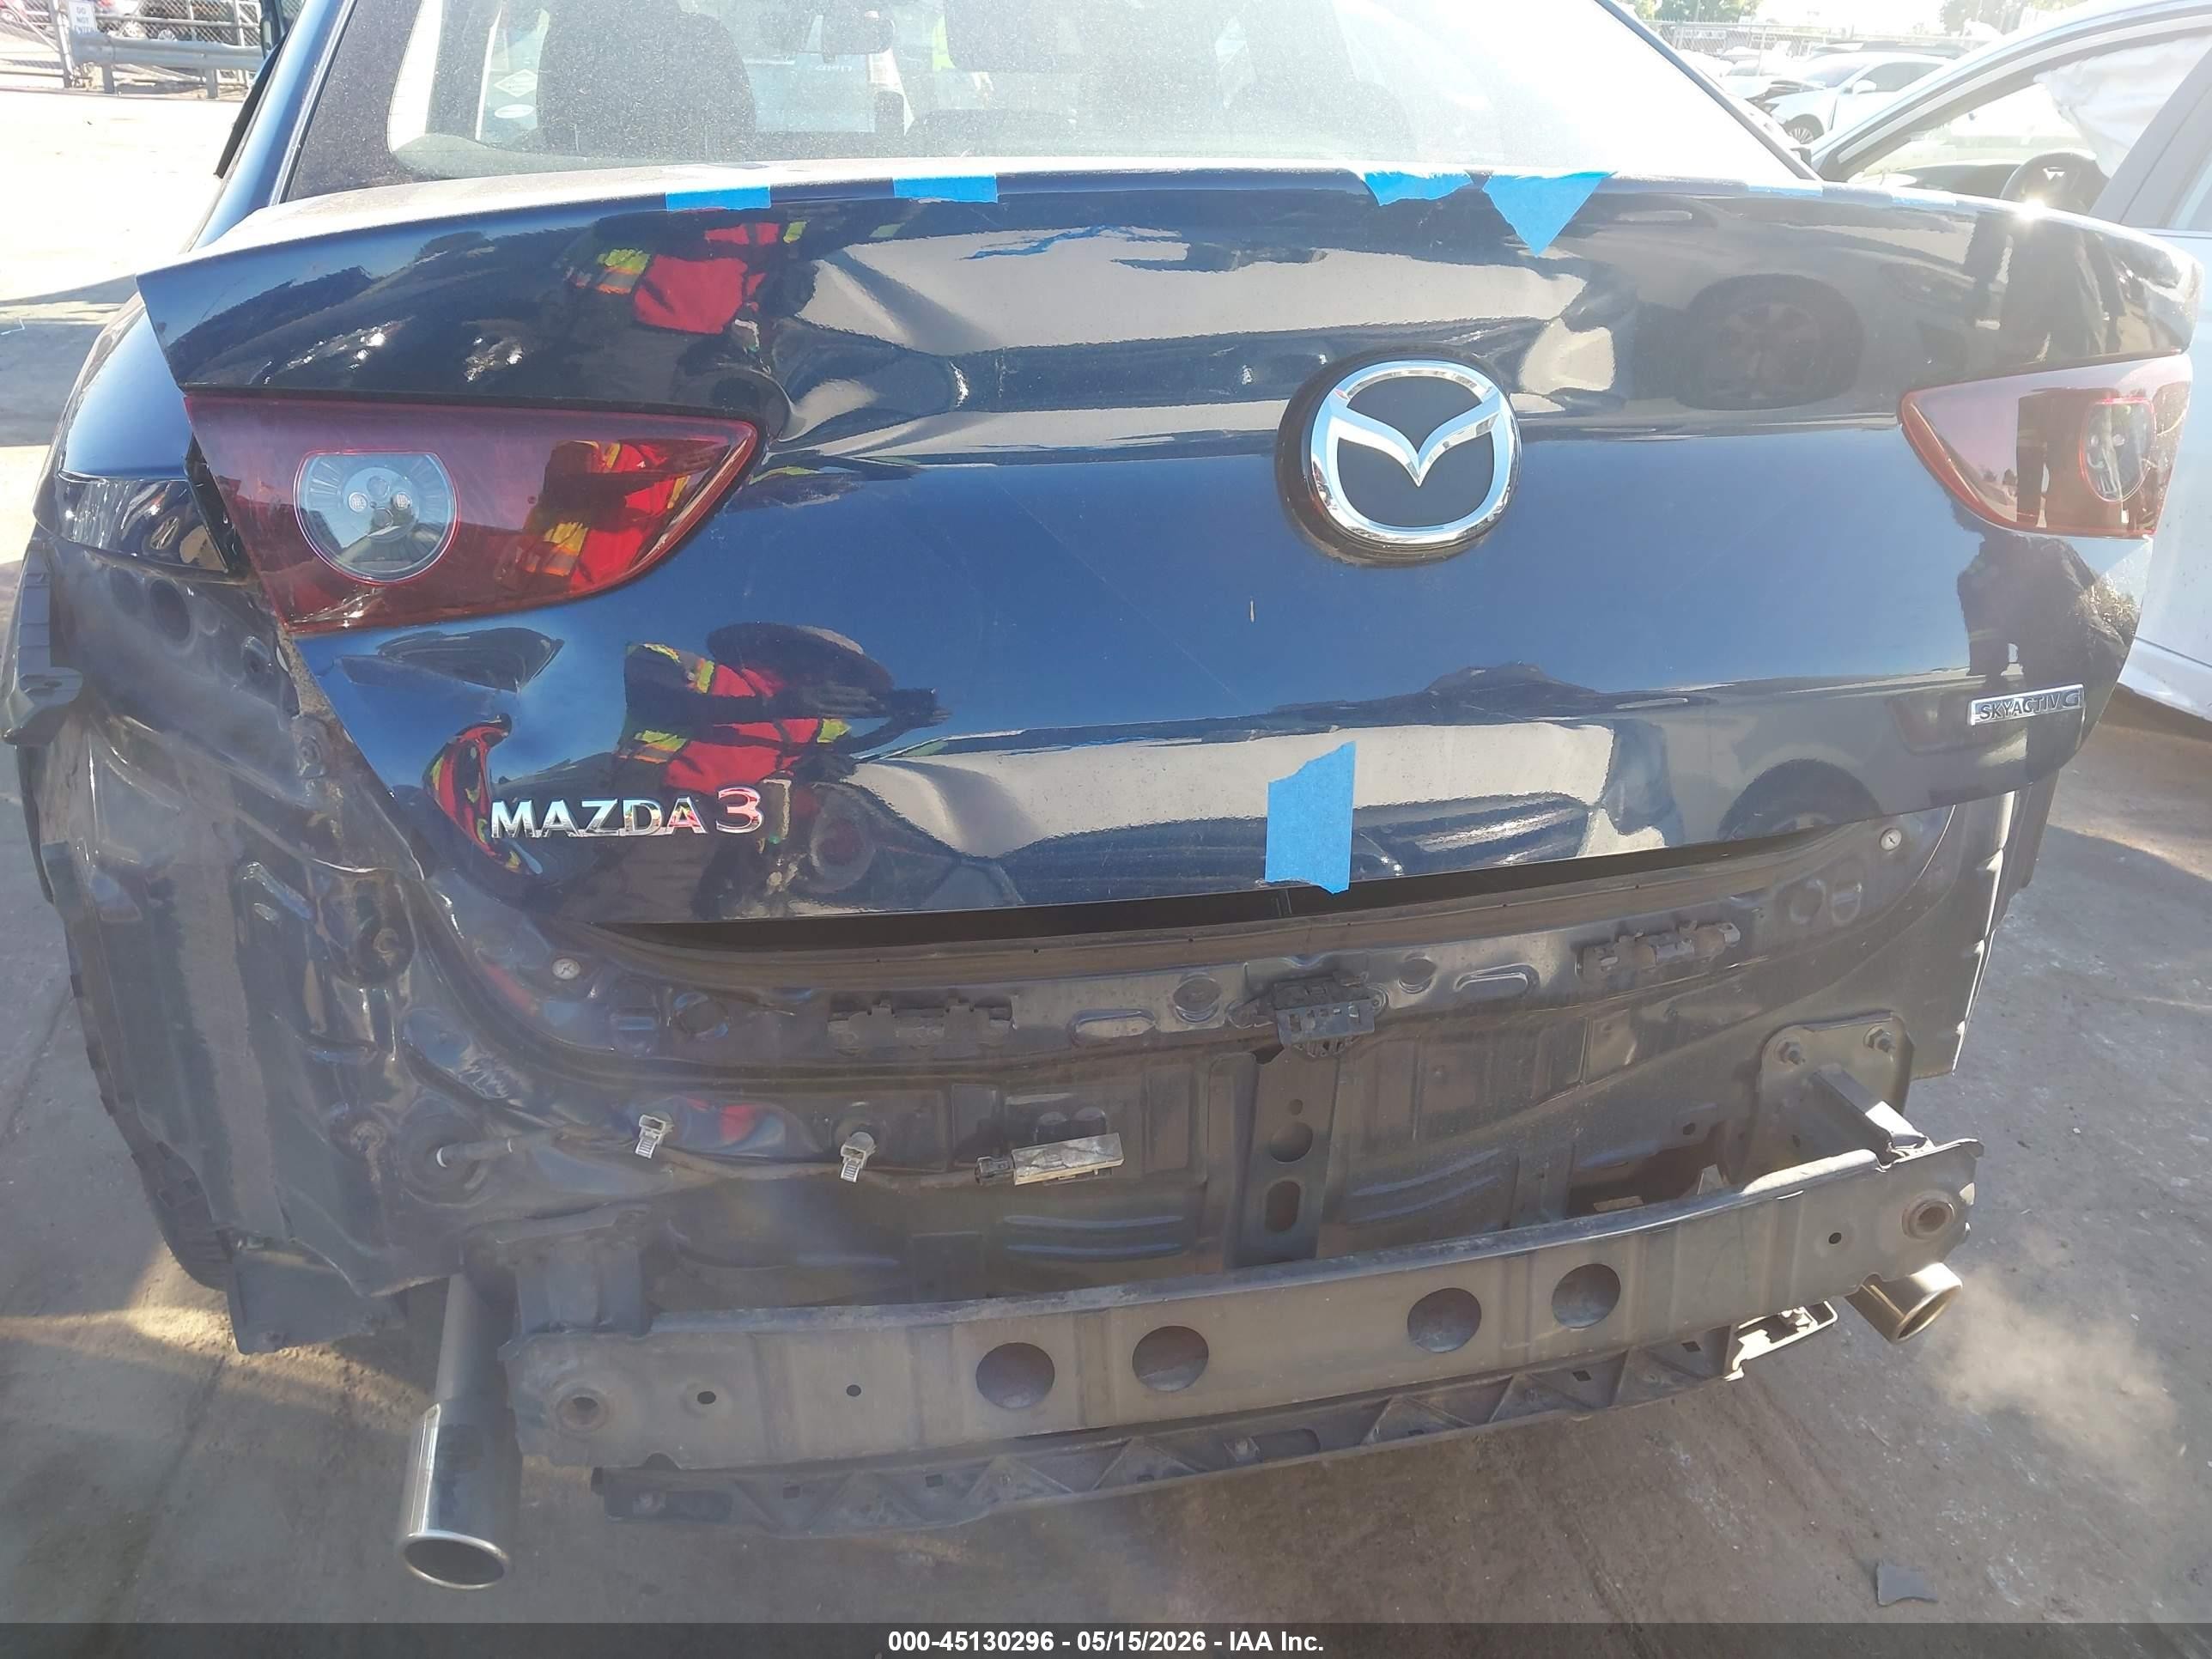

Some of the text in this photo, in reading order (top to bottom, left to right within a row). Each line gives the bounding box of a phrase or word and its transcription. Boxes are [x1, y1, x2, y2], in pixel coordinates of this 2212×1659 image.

[76, 6, 87, 15] DO
[490, 787, 763, 838] MAZDA 3
